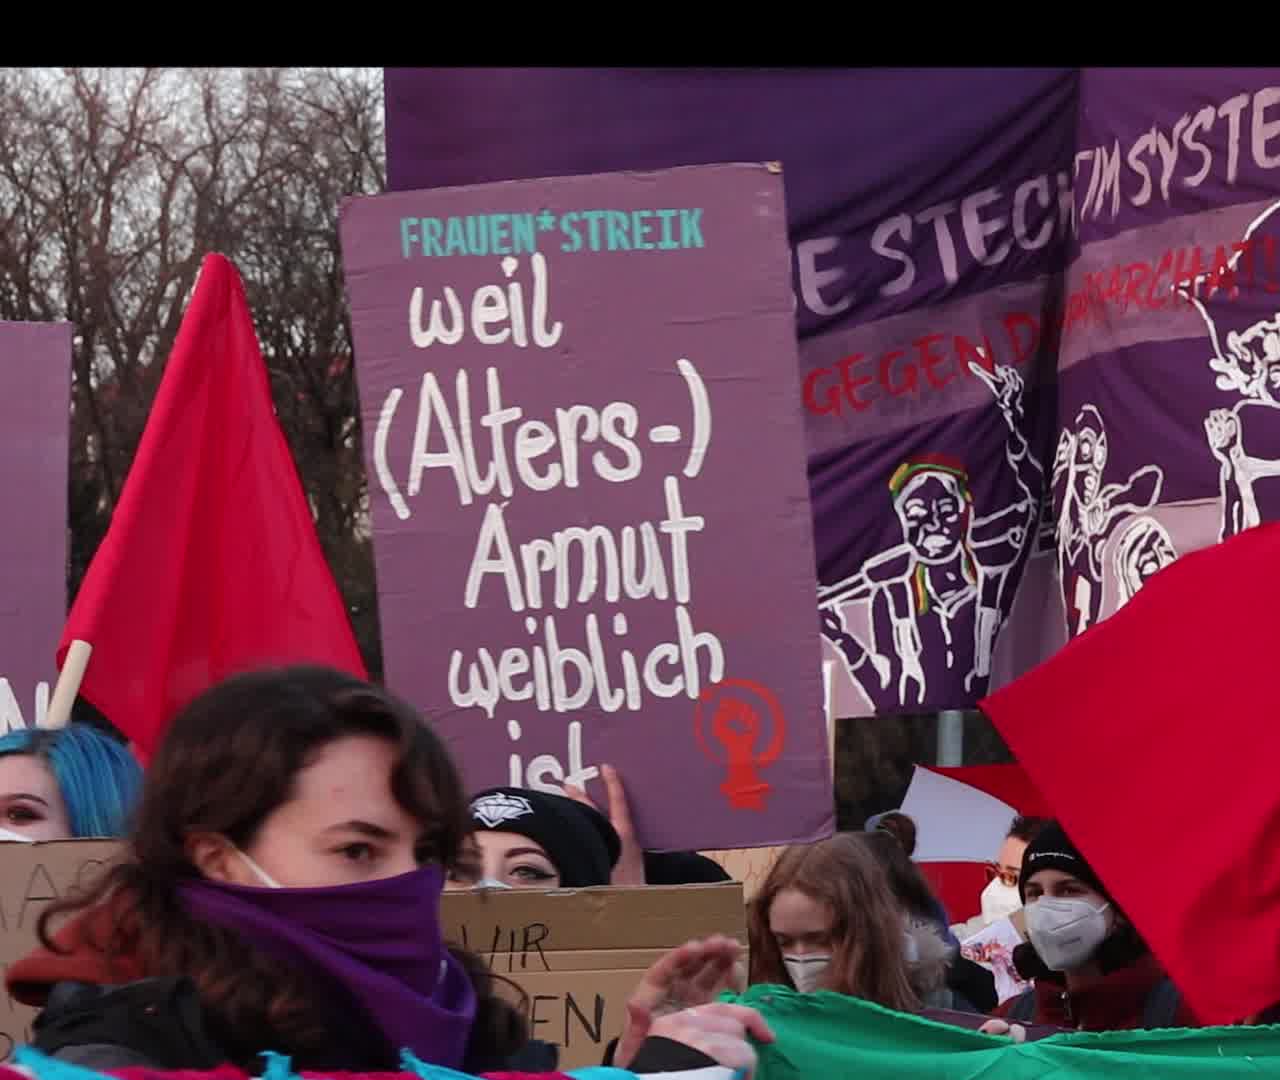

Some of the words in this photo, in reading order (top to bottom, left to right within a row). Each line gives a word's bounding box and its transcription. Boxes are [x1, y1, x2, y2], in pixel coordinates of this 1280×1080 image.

[409, 253, 562, 348] weil
[803, 330, 994, 417] GEGEN
[373, 359, 711, 519] (Alters-)
[464, 476, 704, 612] Armut
[448, 605, 725, 718] weiblich
[509, 721, 600, 793] ist
